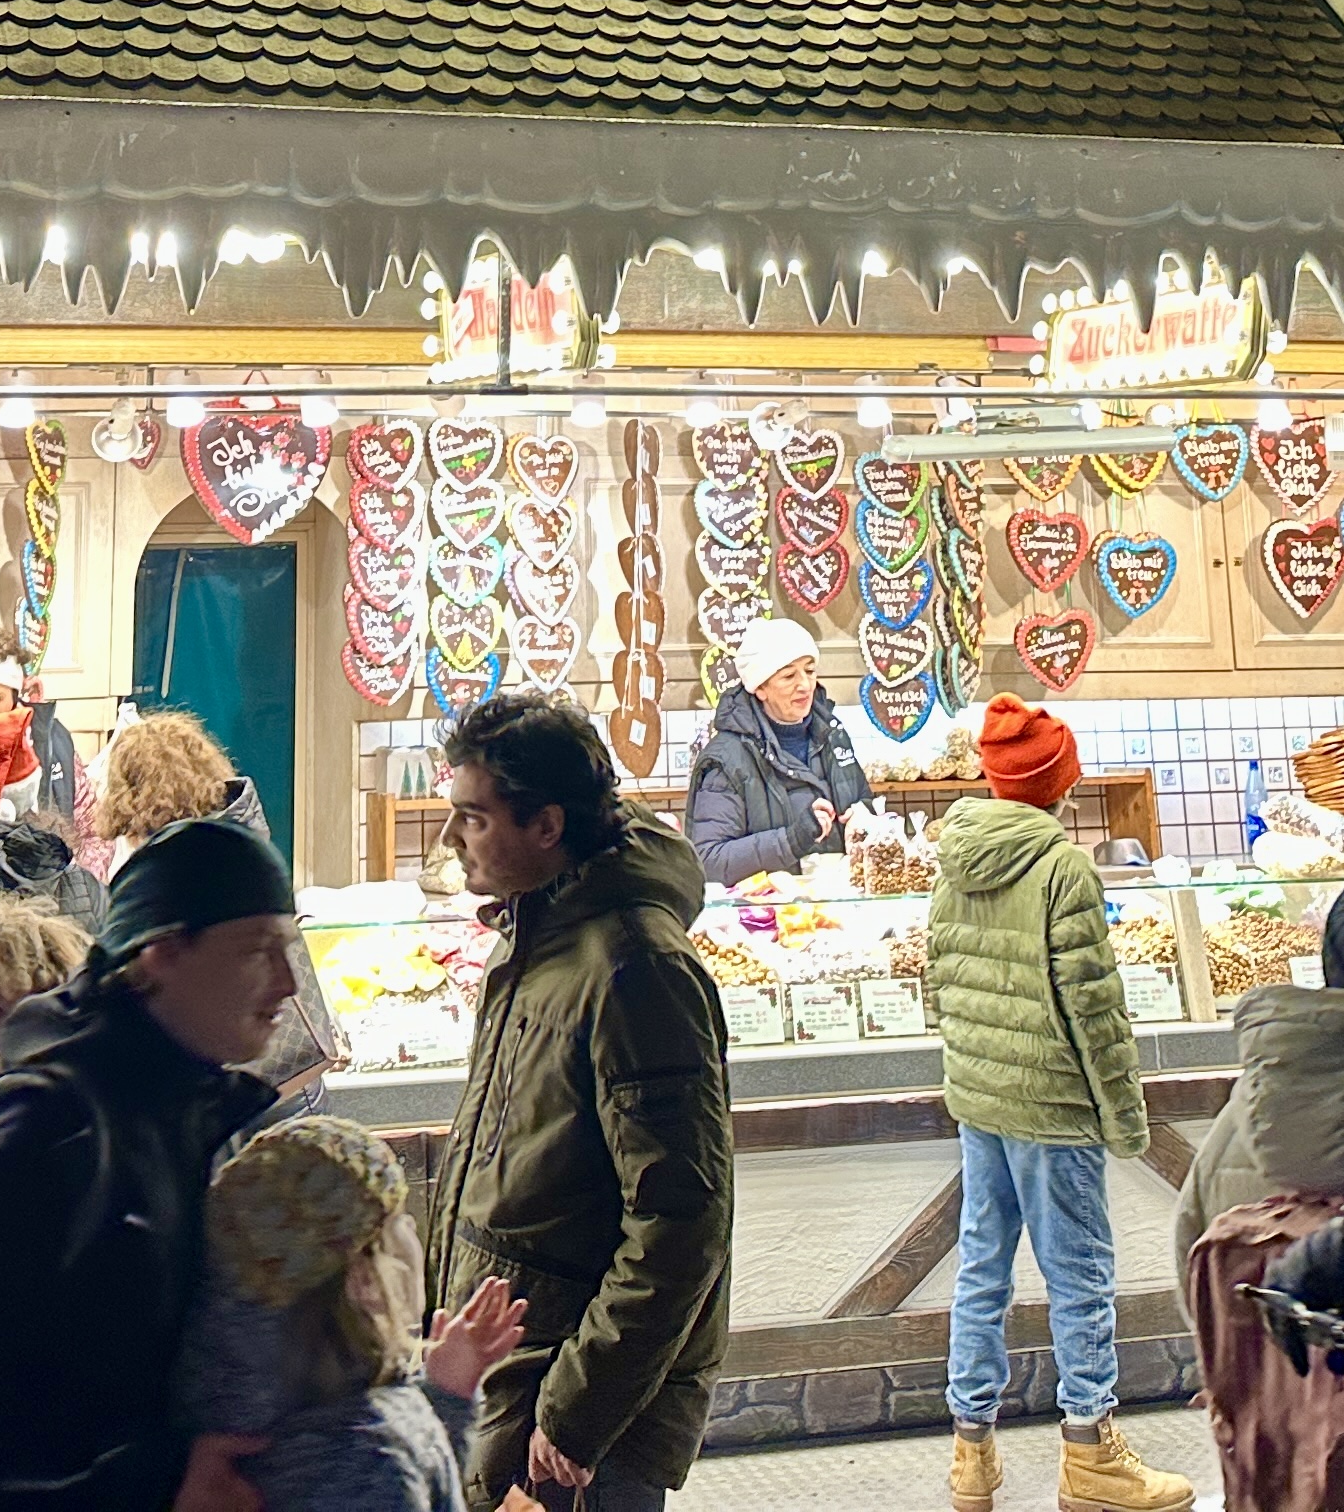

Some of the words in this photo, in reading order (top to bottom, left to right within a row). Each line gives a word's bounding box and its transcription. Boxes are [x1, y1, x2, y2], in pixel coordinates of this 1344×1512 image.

[207, 431, 256, 466] Ich
[1184, 440, 1219, 456] Bleib
[1278, 440, 1314, 460] Ich
[1197, 452, 1227, 467] treu
[1275, 460, 1320, 480] liebe
[1281, 478, 1316, 497] Dich
[1291, 541, 1321, 560] Ich
[1110, 552, 1142, 569] Bleib
[1291, 559, 1327, 578] liebe
[1127, 568, 1154, 581] treu
[1294, 579, 1323, 596] Dich
[875, 591, 910, 602] meine
[874, 688, 928, 703] Vernasch
[887, 703, 921, 717] mich
